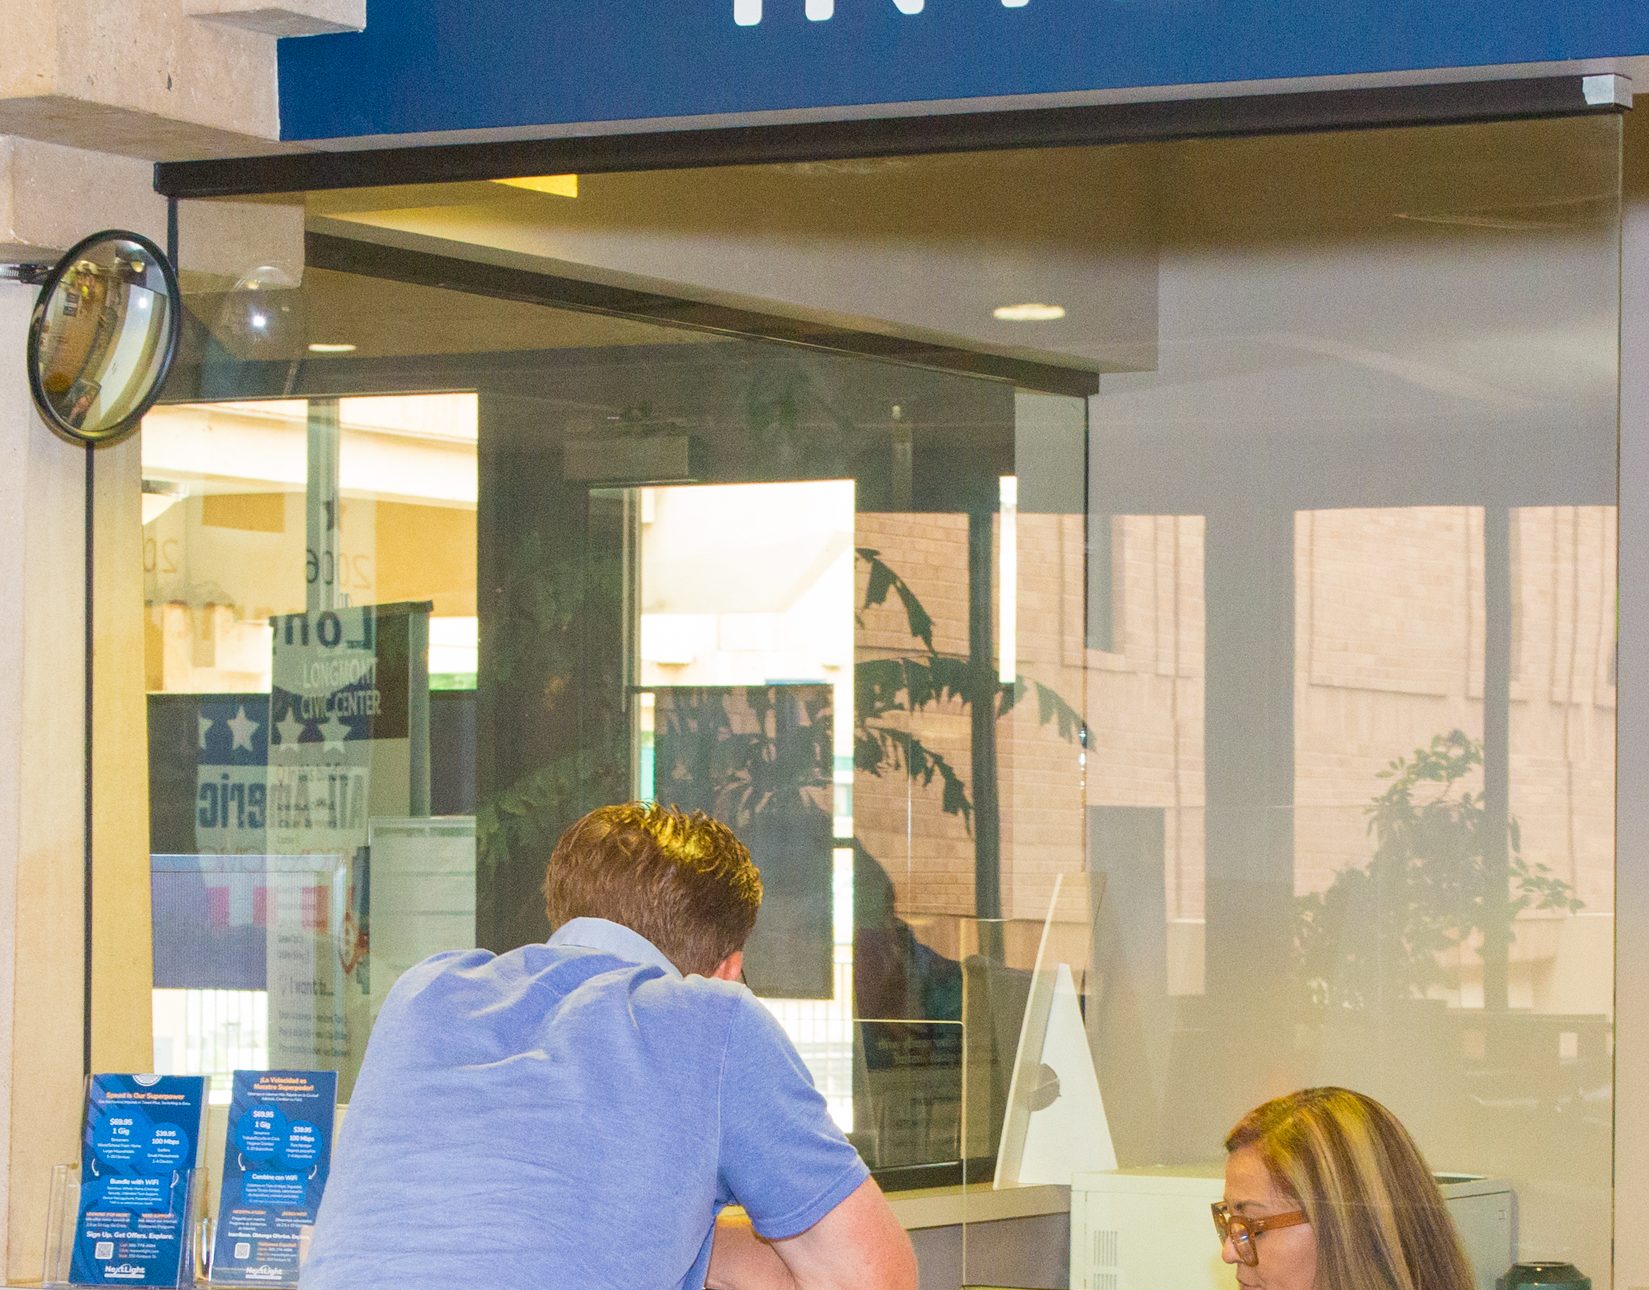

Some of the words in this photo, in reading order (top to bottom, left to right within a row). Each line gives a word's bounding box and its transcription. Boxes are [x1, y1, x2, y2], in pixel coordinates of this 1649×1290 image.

[118, 1127, 130, 1136] Gig
[86, 1231, 101, 1239] Sign
[114, 1231, 125, 1239] Get
[149, 1232, 174, 1240] Explore.
[104, 1263, 146, 1274] NextLight
